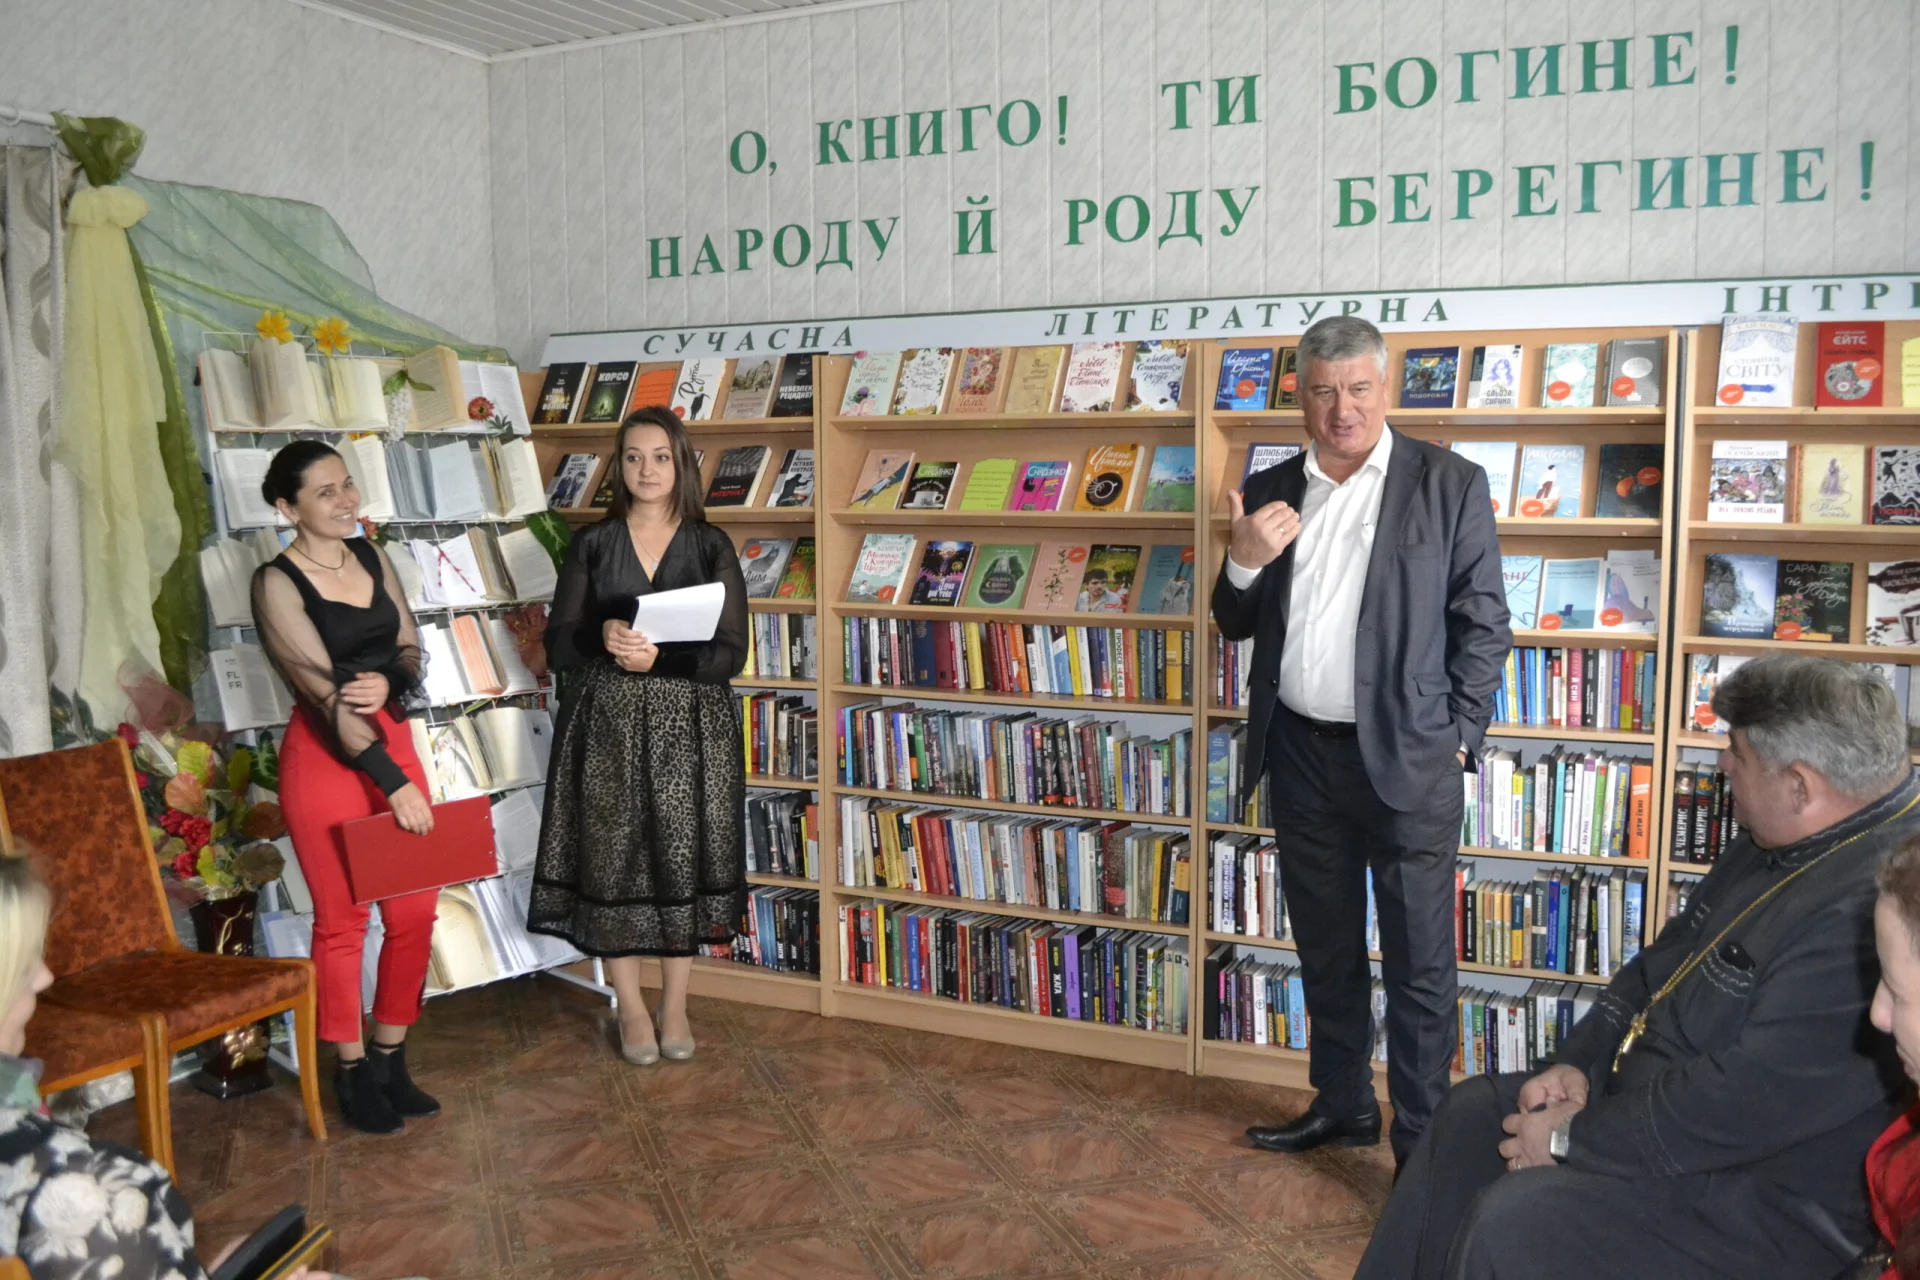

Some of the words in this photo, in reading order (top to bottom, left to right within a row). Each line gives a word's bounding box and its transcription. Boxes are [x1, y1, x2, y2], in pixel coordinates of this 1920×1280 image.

[730, 131, 777, 176] О,
[816, 96, 1068, 166] КНИГО!
[1162, 74, 1262, 131] ТИ
[1333, 26, 1740, 115] БОГИНЕ!
[646, 217, 900, 280] НАРОДУ
[953, 195, 998, 256] Й
[1063, 186, 1261, 250] РОДУ
[1332, 142, 1875, 228] БЕРЕГИНЕ!
[643, 326, 853, 355] СУЧАСНА
[1044, 297, 1450, 338] ЛІТЕРАТУРНА
[598, 372, 629, 382] КОРСО
[1725, 364, 1787, 378] СВІТУ
[711, 489, 746, 498] ІНТЕРНАТ
[1786, 563, 1816, 573] САРА
[1818, 565, 1850, 575] ДЖІО
[1676, 807, 1689, 846] ЧЕМЕРИС
[1694, 804, 1708, 846] ЧЕМЕРИС
[1624, 901, 1633, 937] БАКМАН
[1053, 973, 1063, 995] ЖАГА
